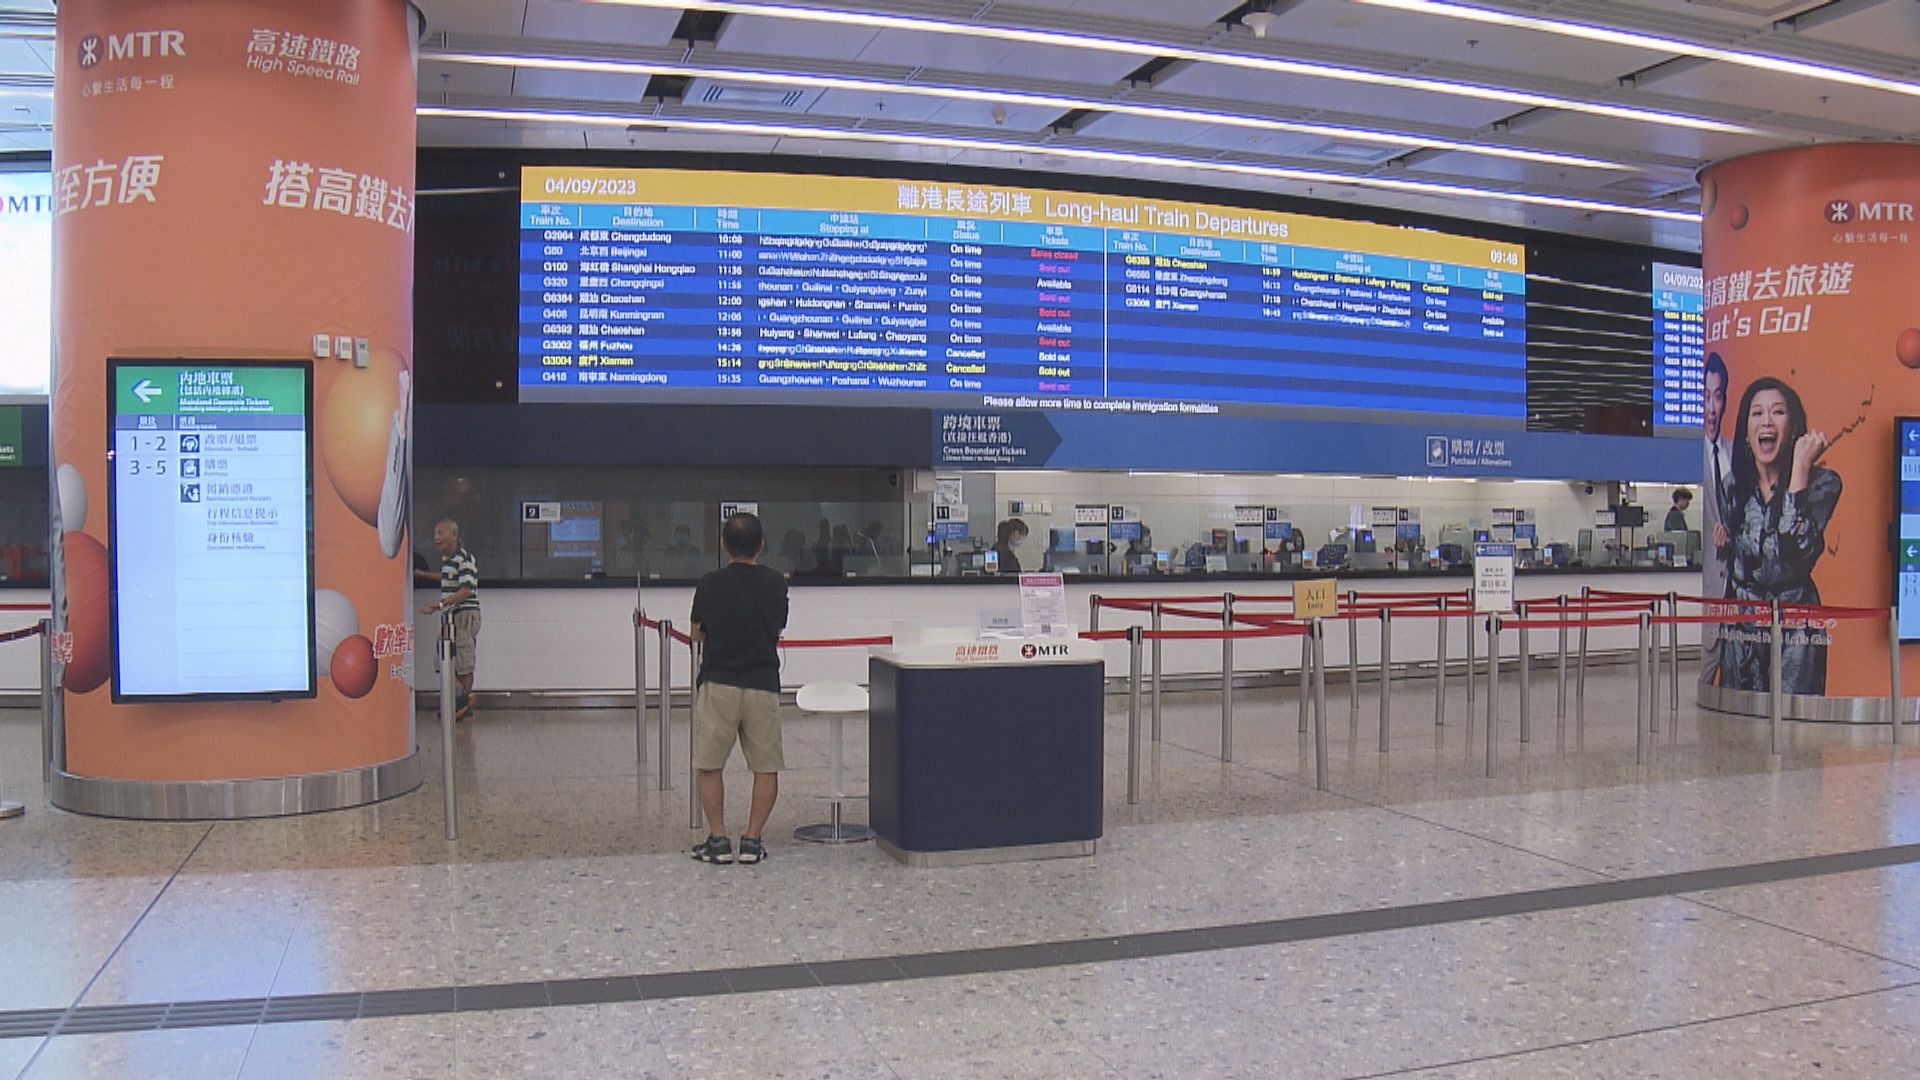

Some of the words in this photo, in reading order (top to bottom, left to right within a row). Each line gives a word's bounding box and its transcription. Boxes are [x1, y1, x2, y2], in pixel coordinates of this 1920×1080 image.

[109, 30, 186, 62] MTR
[247, 28, 360, 71] 高速鐵路
[247, 55, 282, 74] High
[286, 62, 334, 81] Speed
[336, 68, 360, 85] Rail
[54, 154, 164, 215] 至方便
[544, 177, 636, 195] 04/09/2023
[8, 195, 52, 213] MT
[263, 159, 413, 233] 搭高鐵去
[897, 184, 1032, 216] 離港長途列車
[1045, 197, 1139, 223] Long-haul
[1144, 204, 1190, 228] Train
[1195, 209, 1288, 237] Departures
[1859, 202, 1914, 222] MTR
[529, 215, 553, 226] Train
[555, 216, 572, 226] No.
[612, 217, 664, 228] Destination
[716, 219, 739, 229] Time
[819, 224, 858, 235] Stopping
[718, 249, 742, 259] 11:00
[950, 258, 963, 267] On
[964, 260, 982, 269] time
[950, 244, 963, 253] On
[964, 245, 982, 255] time
[611, 263, 653, 274] Shanghai
[654, 264, 696, 276] Hongqiao
[950, 274, 963, 283] On
[964, 275, 982, 285] time
[1663, 271, 1703, 289] 04/09/202
[950, 289, 963, 298] On
[964, 290, 982, 299] time
[601, 295, 646, 304] Chaoshan
[950, 304, 963, 313] On
[964, 305, 982, 314] time
[610, 310, 665, 321] Kunmingnan
[950, 319, 963, 328] On
[964, 320, 982, 329] time
[1705, 307, 1750, 344] Let's
[1759, 304, 1811, 336] Go!
[600, 325, 645, 335] Chaoshan
[950, 334, 963, 343] On
[964, 334, 982, 344] time
[600, 341, 633, 351] Fuzhou
[600, 356, 634, 366] Xiamen
[610, 373, 667, 384] Nanningdong
[950, 379, 963, 388] On
[964, 380, 982, 389] time
[984, 396, 1013, 407] Please
[1015, 396, 1038, 408] allow
[1039, 399, 1061, 408] more
[1063, 398, 1082, 409] time
[1083, 399, 1091, 409] to
[1093, 400, 1131, 412] complete
[1133, 401, 1178, 414] immigration
[1179, 402, 1219, 413] formalities
[943, 414, 1001, 431] 跨境車票
[943, 446, 963, 455] Cross
[964, 446, 1000, 456] Boundary
[1001, 446, 1026, 455] Tickets
[1038, 644, 1068, 656] MTR
